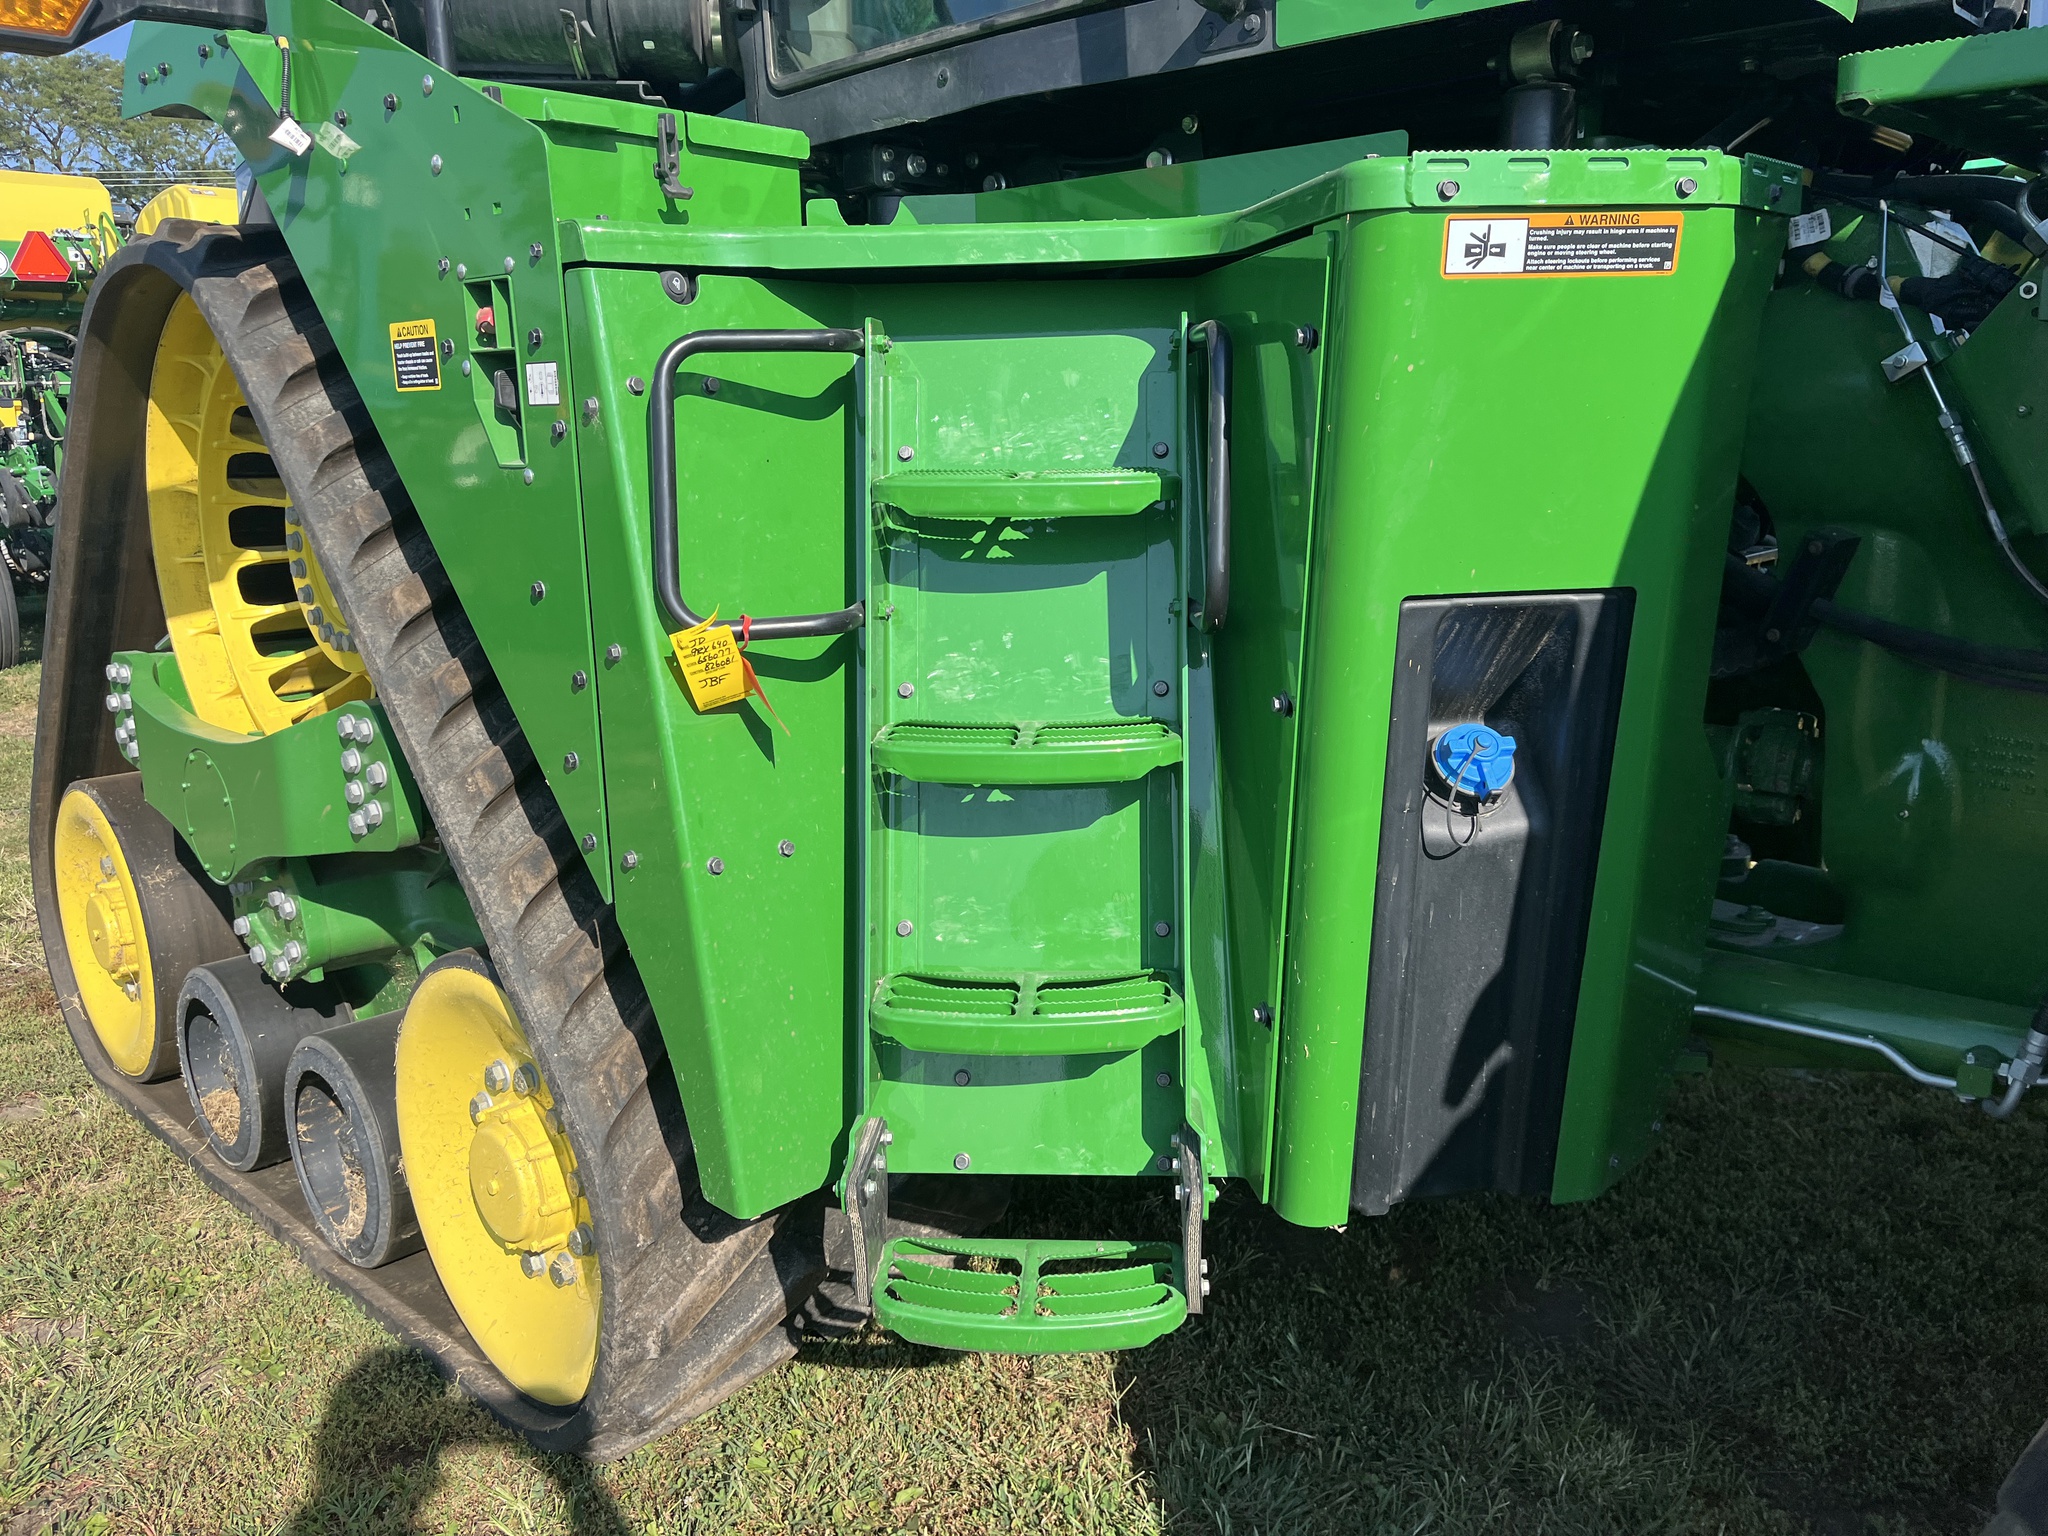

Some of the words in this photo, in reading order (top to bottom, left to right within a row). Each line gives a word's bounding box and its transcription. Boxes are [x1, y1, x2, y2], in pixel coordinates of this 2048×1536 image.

[1579, 213, 1640, 225] WARNING
[1557, 243, 1575, 251] people
[1651, 241, 1672, 249] starting
[402, 325, 429, 337] CAUTION
[689, 637, 706, 648] JD
[711, 640, 728, 650] 640
[697, 648, 731, 664] 656077
[698, 672, 731, 689] JBF
